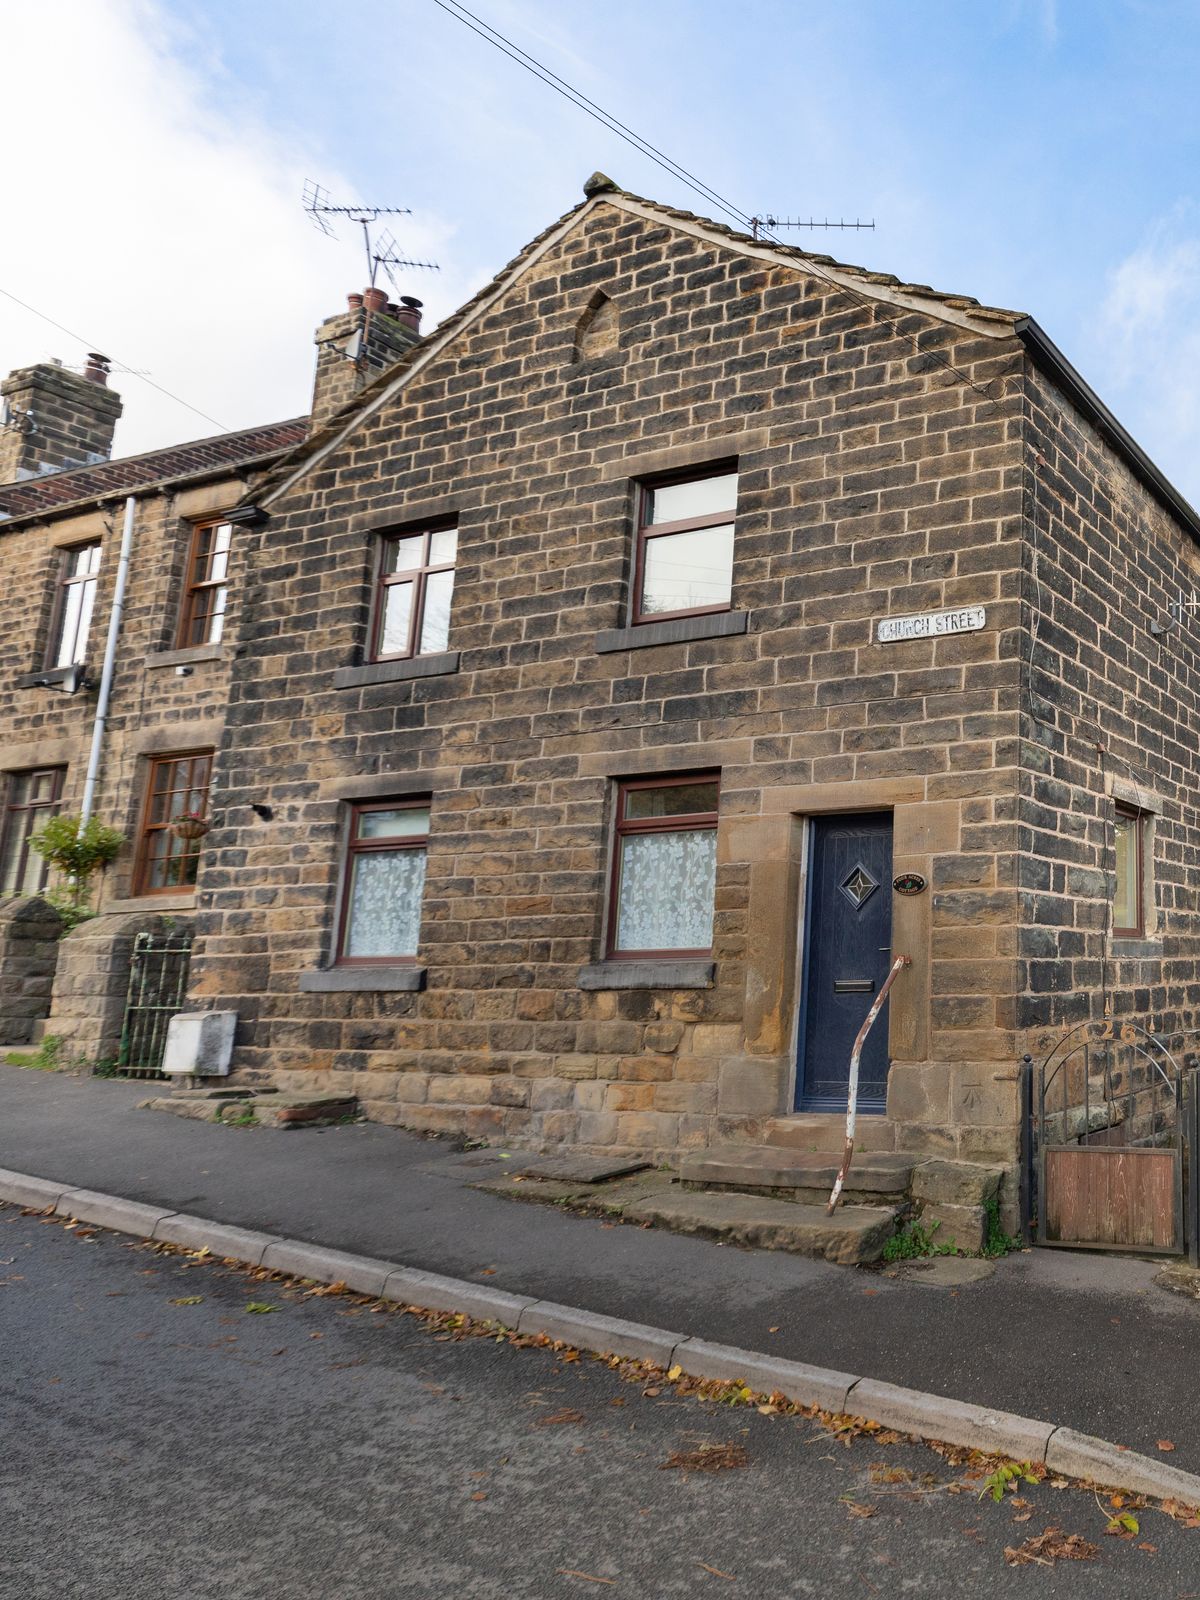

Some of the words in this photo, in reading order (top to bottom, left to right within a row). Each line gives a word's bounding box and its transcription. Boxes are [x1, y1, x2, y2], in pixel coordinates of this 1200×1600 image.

[882, 618, 930, 639] CHURCH
[935, 610, 982, 632] STREET
[1081, 1020, 1137, 1044] 126
